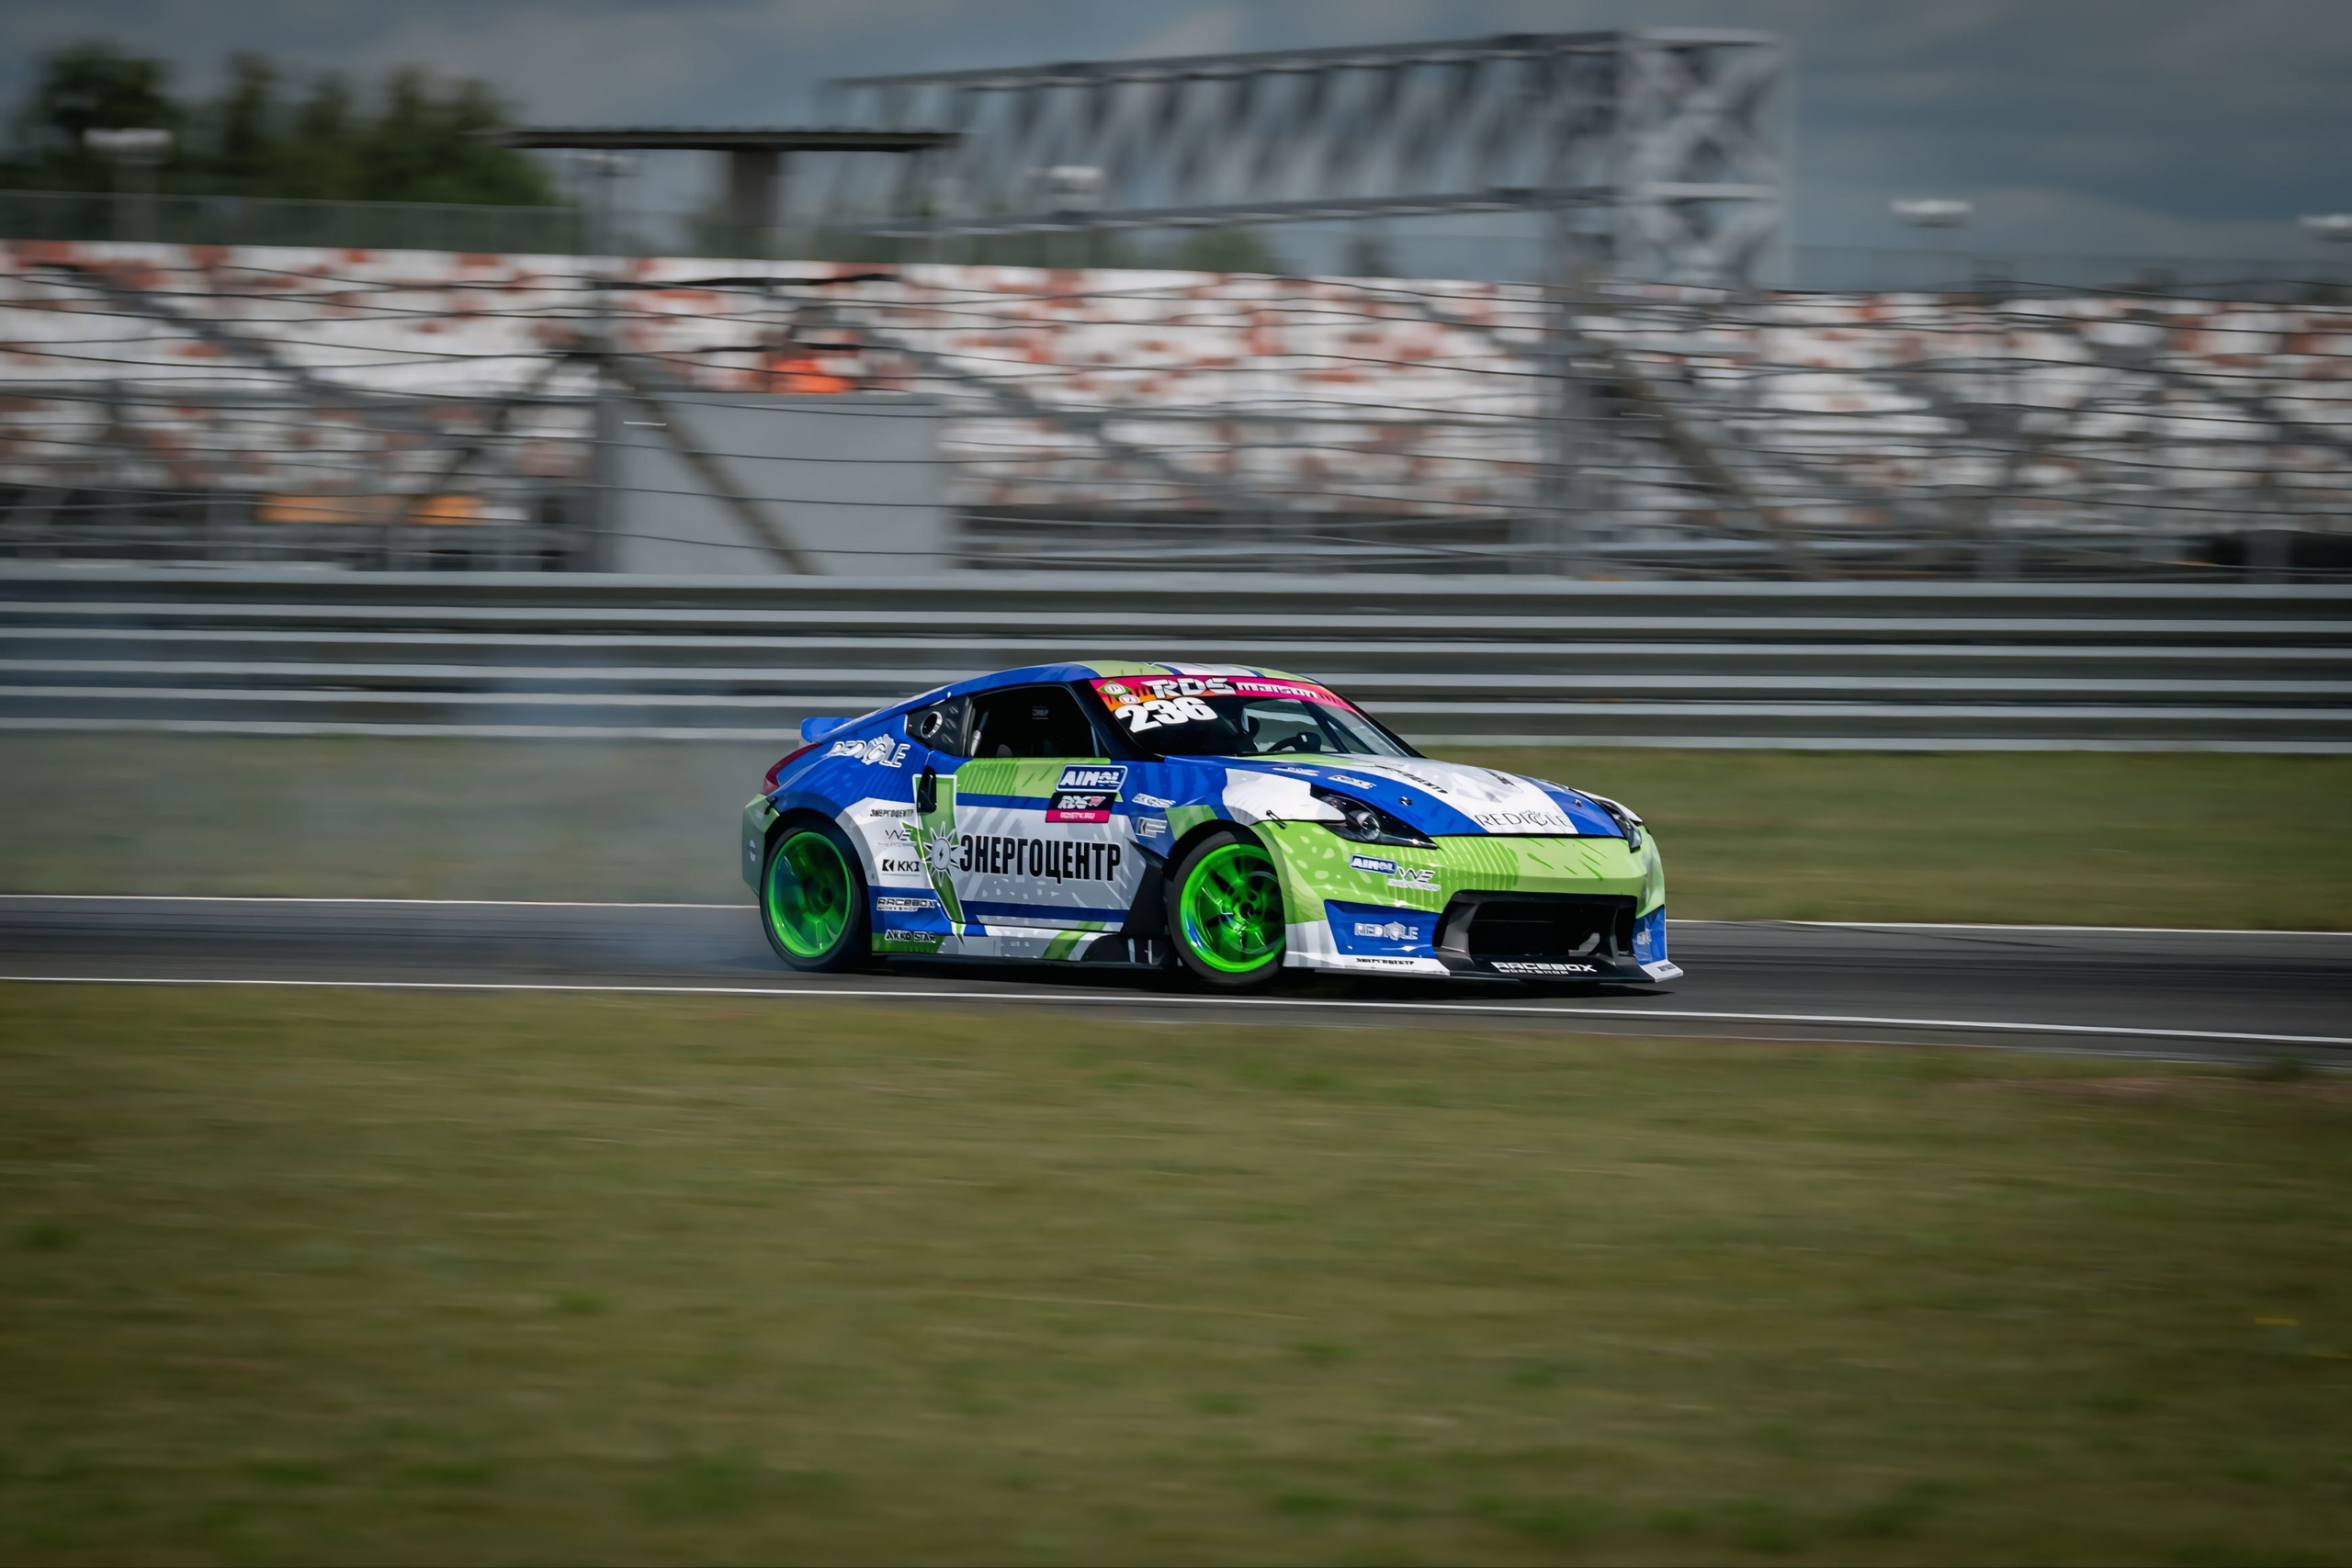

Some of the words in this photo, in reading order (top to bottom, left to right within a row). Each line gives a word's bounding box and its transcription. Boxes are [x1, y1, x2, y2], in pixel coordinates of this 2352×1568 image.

[1140, 678, 1237, 698] RDS
[1114, 696, 1218, 733] 236
[959, 834, 1121, 885] ЭНЕРГОЦЕНТР
